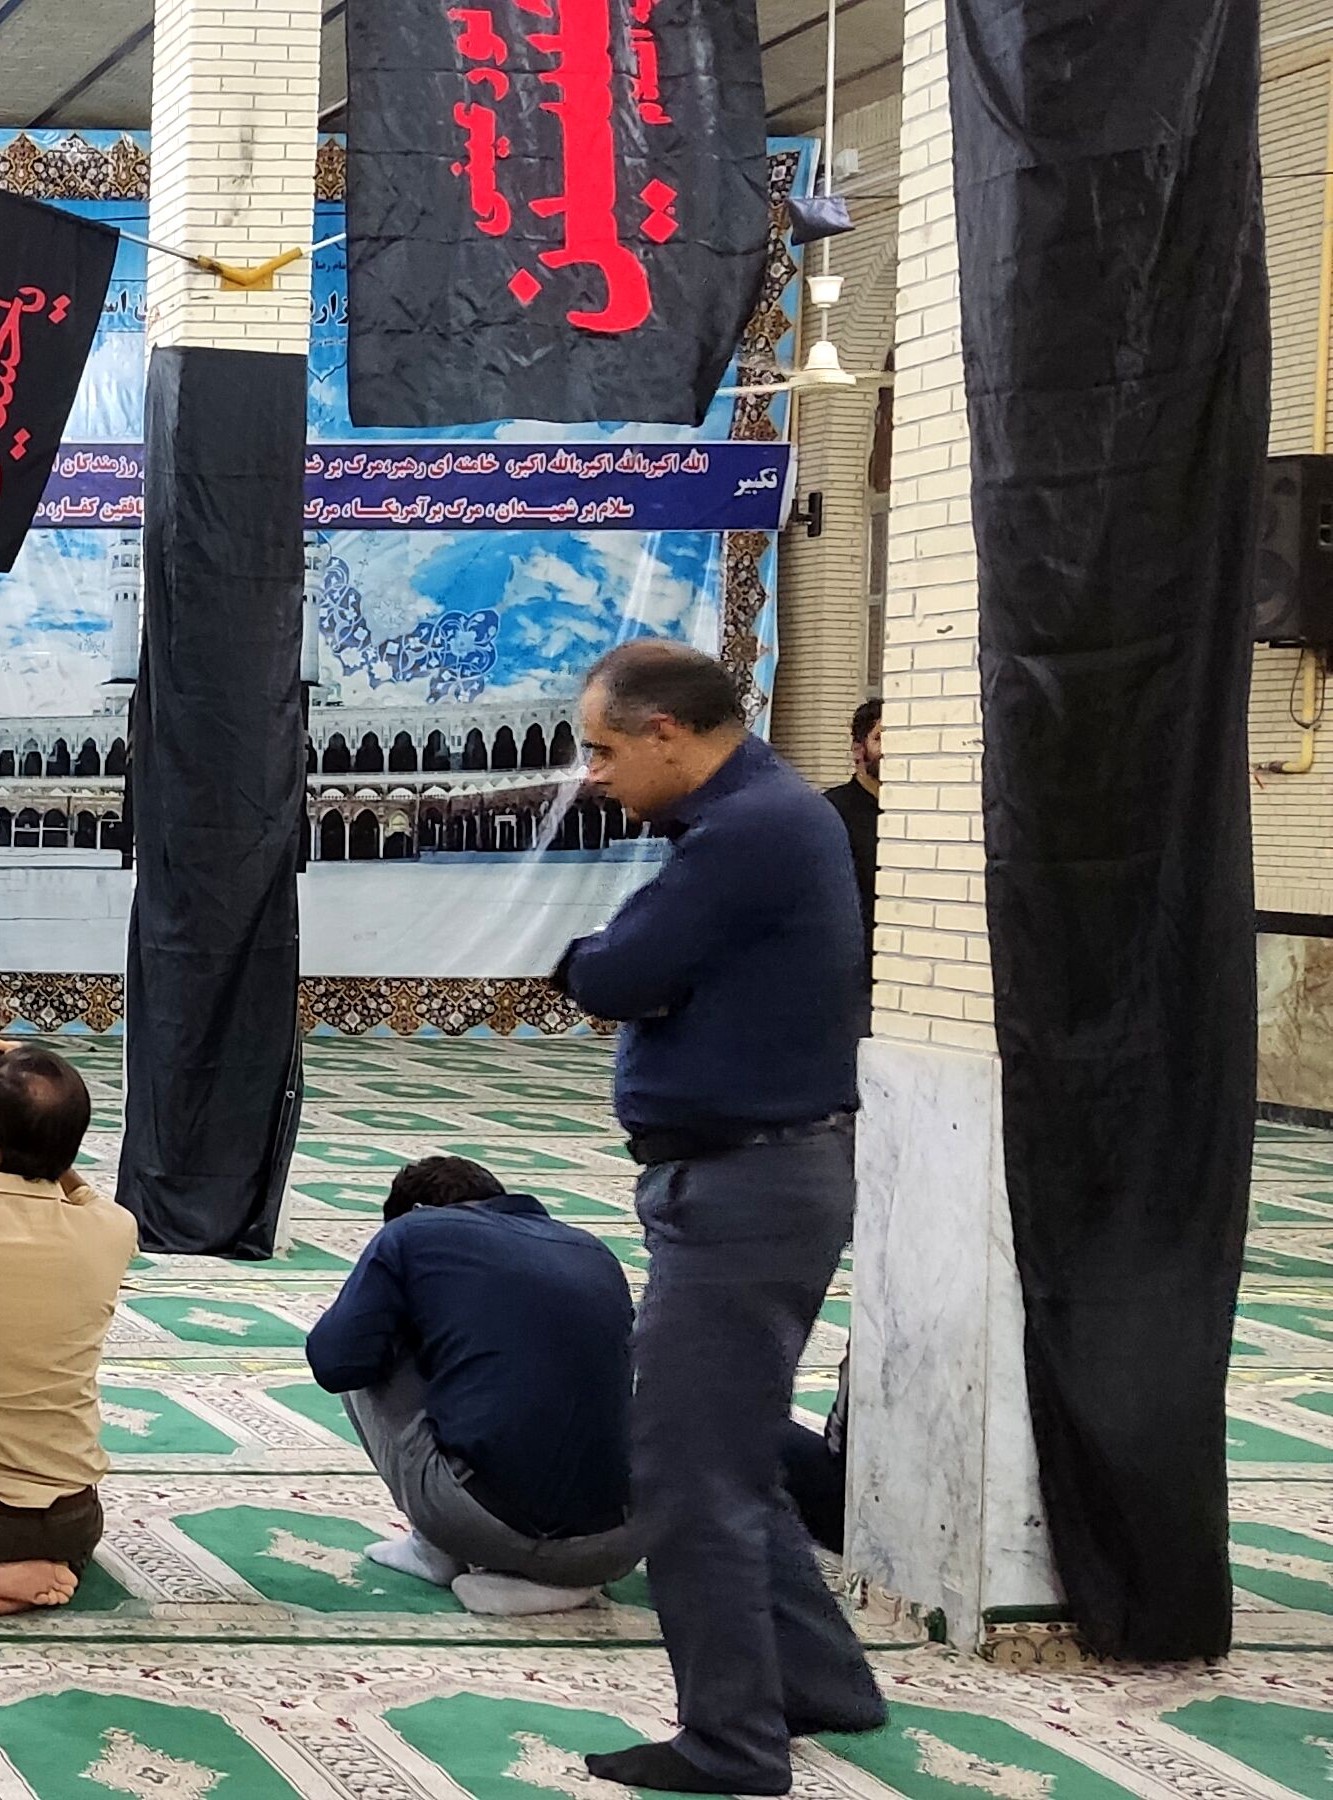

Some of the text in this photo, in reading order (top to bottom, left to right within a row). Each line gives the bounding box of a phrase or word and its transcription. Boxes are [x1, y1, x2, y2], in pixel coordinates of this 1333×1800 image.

[323, 455, 343, 479] بر
[429, 452, 452, 480] ای
[454, 452, 500, 475] خامنه
[733, 468, 779, 496] تکبیر
[445, 499, 486, 525] مرگ
[578, 499, 596, 523] بر
[596, 497, 634, 523] سلام
